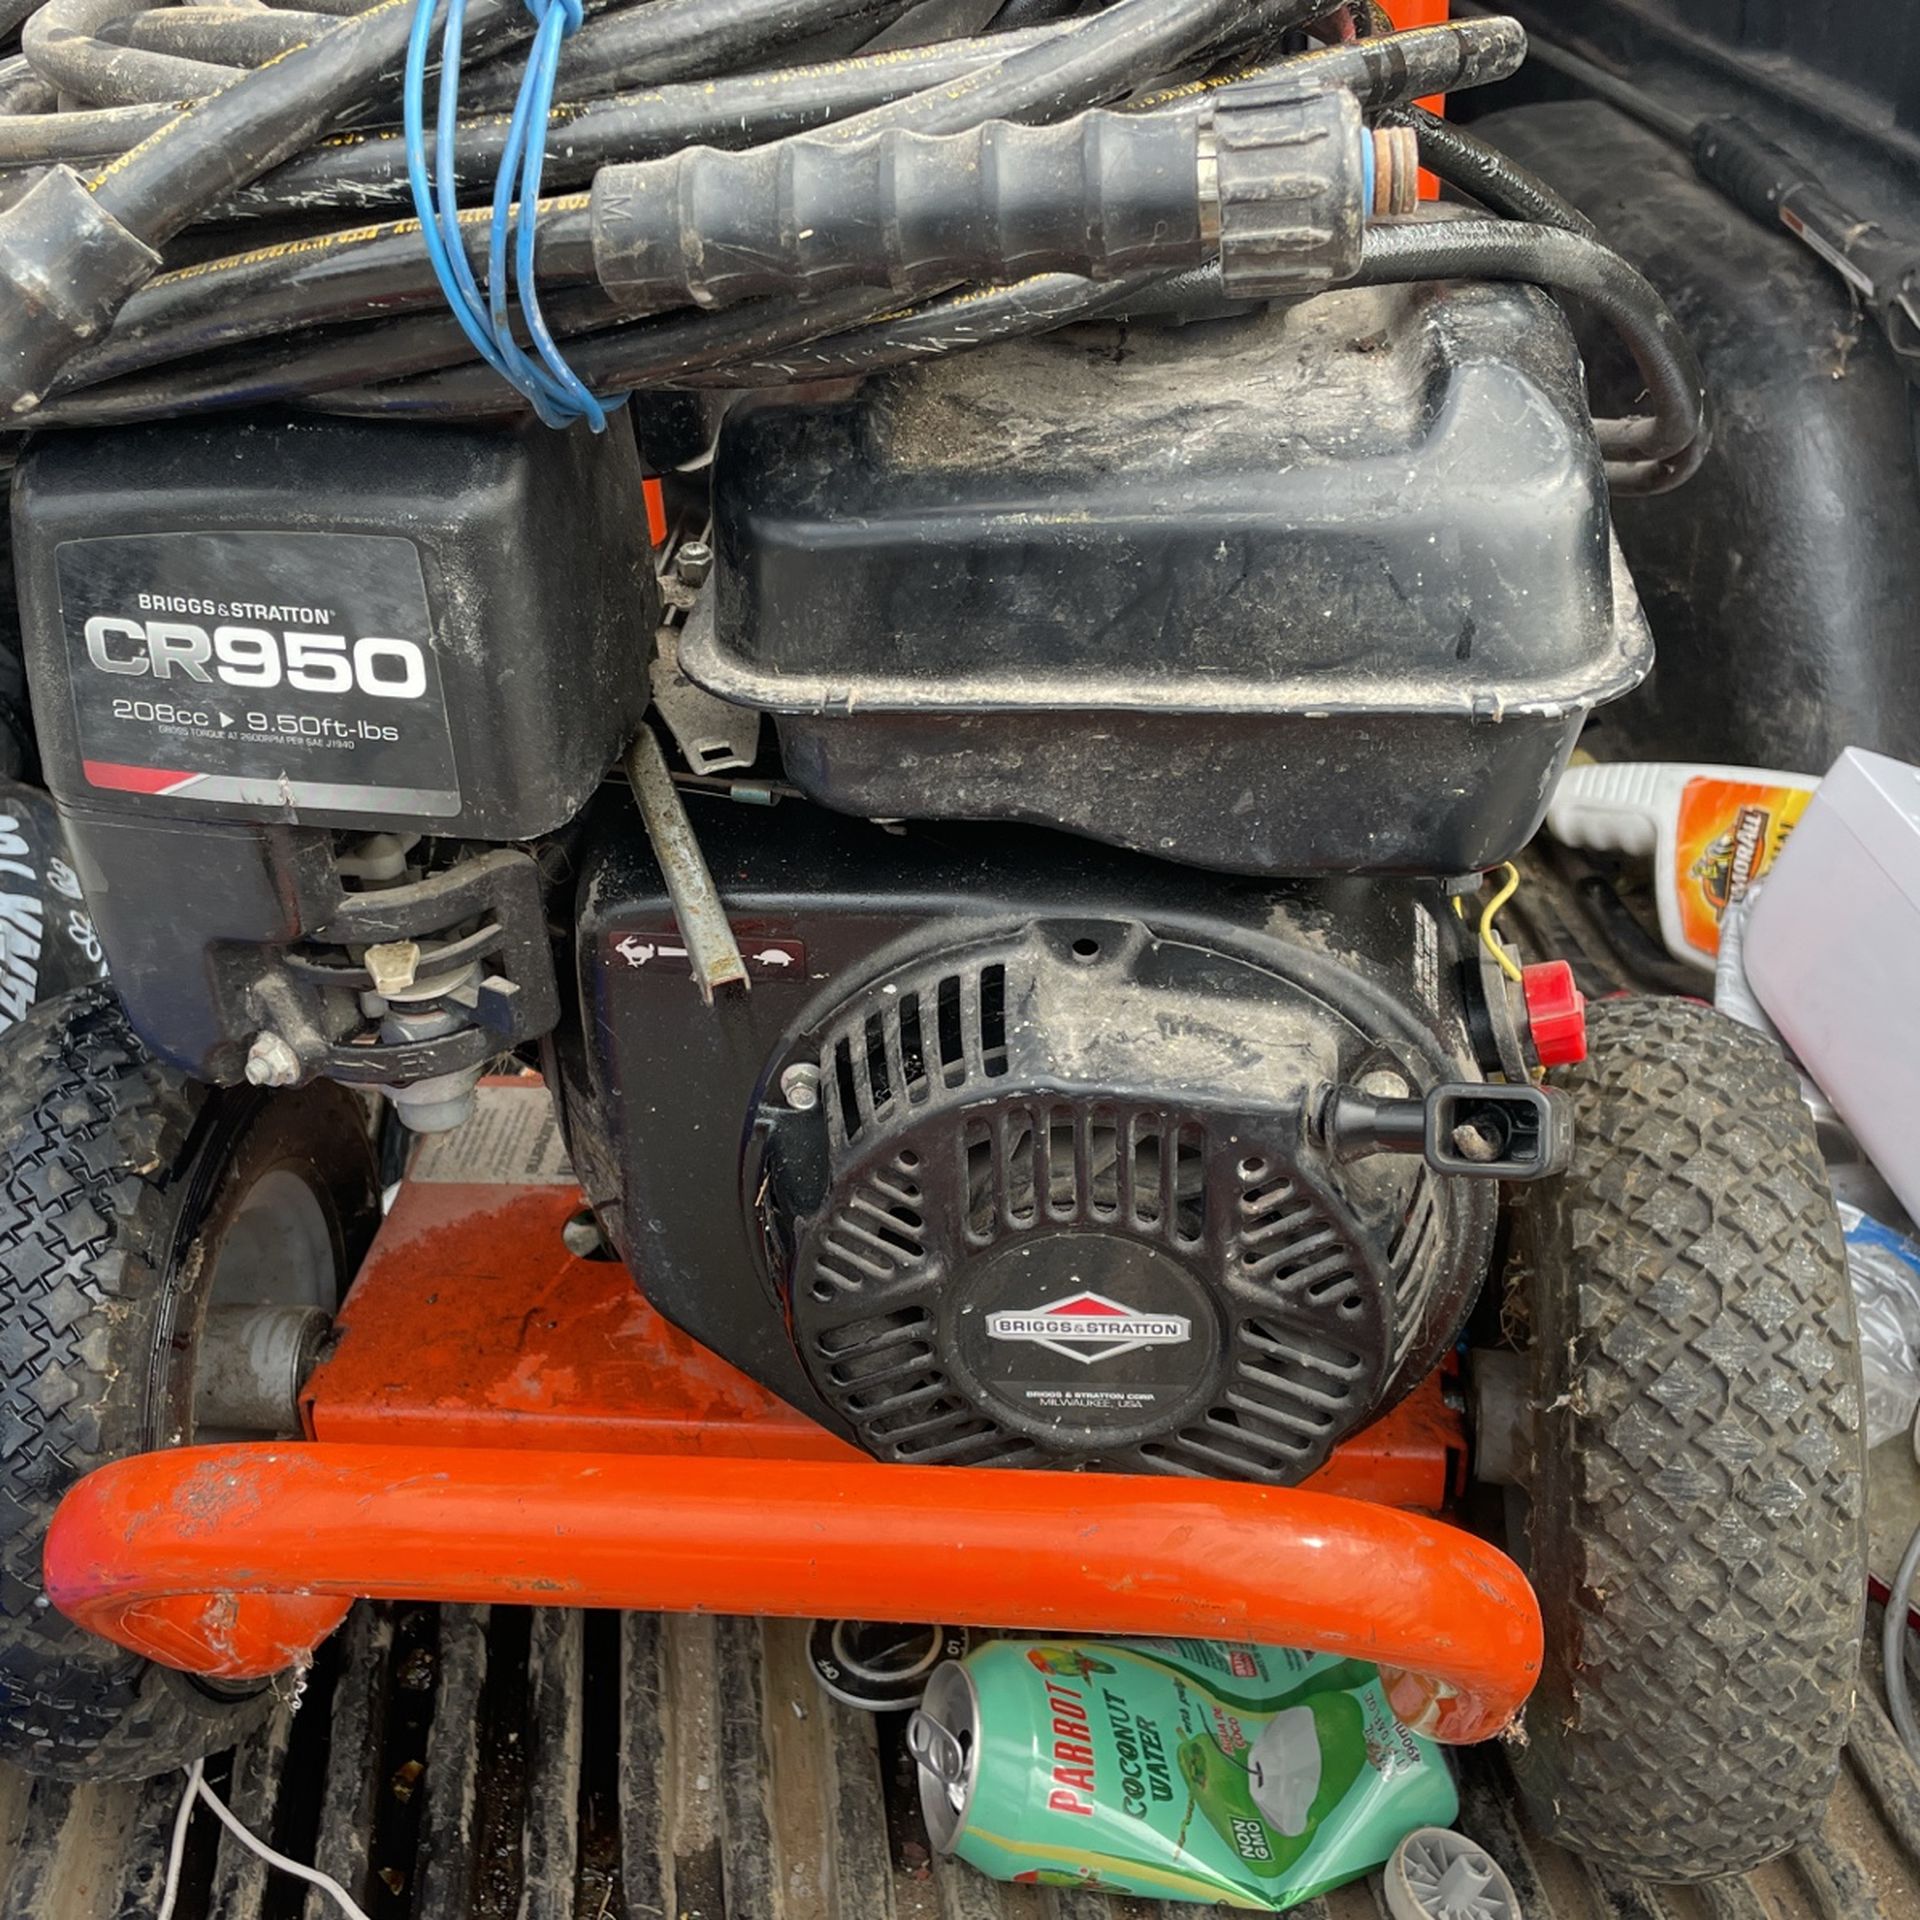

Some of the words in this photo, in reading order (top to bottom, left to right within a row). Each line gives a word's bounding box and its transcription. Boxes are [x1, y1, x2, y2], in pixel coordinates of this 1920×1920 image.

[84, 616, 427, 699] CR950
[112, 699, 209, 727] 208cc
[247, 712, 399, 742] 9.50ft-lbs
[1026, 1391, 1062, 1399] BRIGGS
[1074, 1391, 1125, 1400] STRATTON
[1045, 1679, 1095, 1817] PARROT
[1102, 1687, 1147, 1820] COCONUT
[1136, 1715, 1174, 1802] WATER
[1233, 1819, 1252, 1858] NON
[1248, 1821, 1269, 1860] GMO
